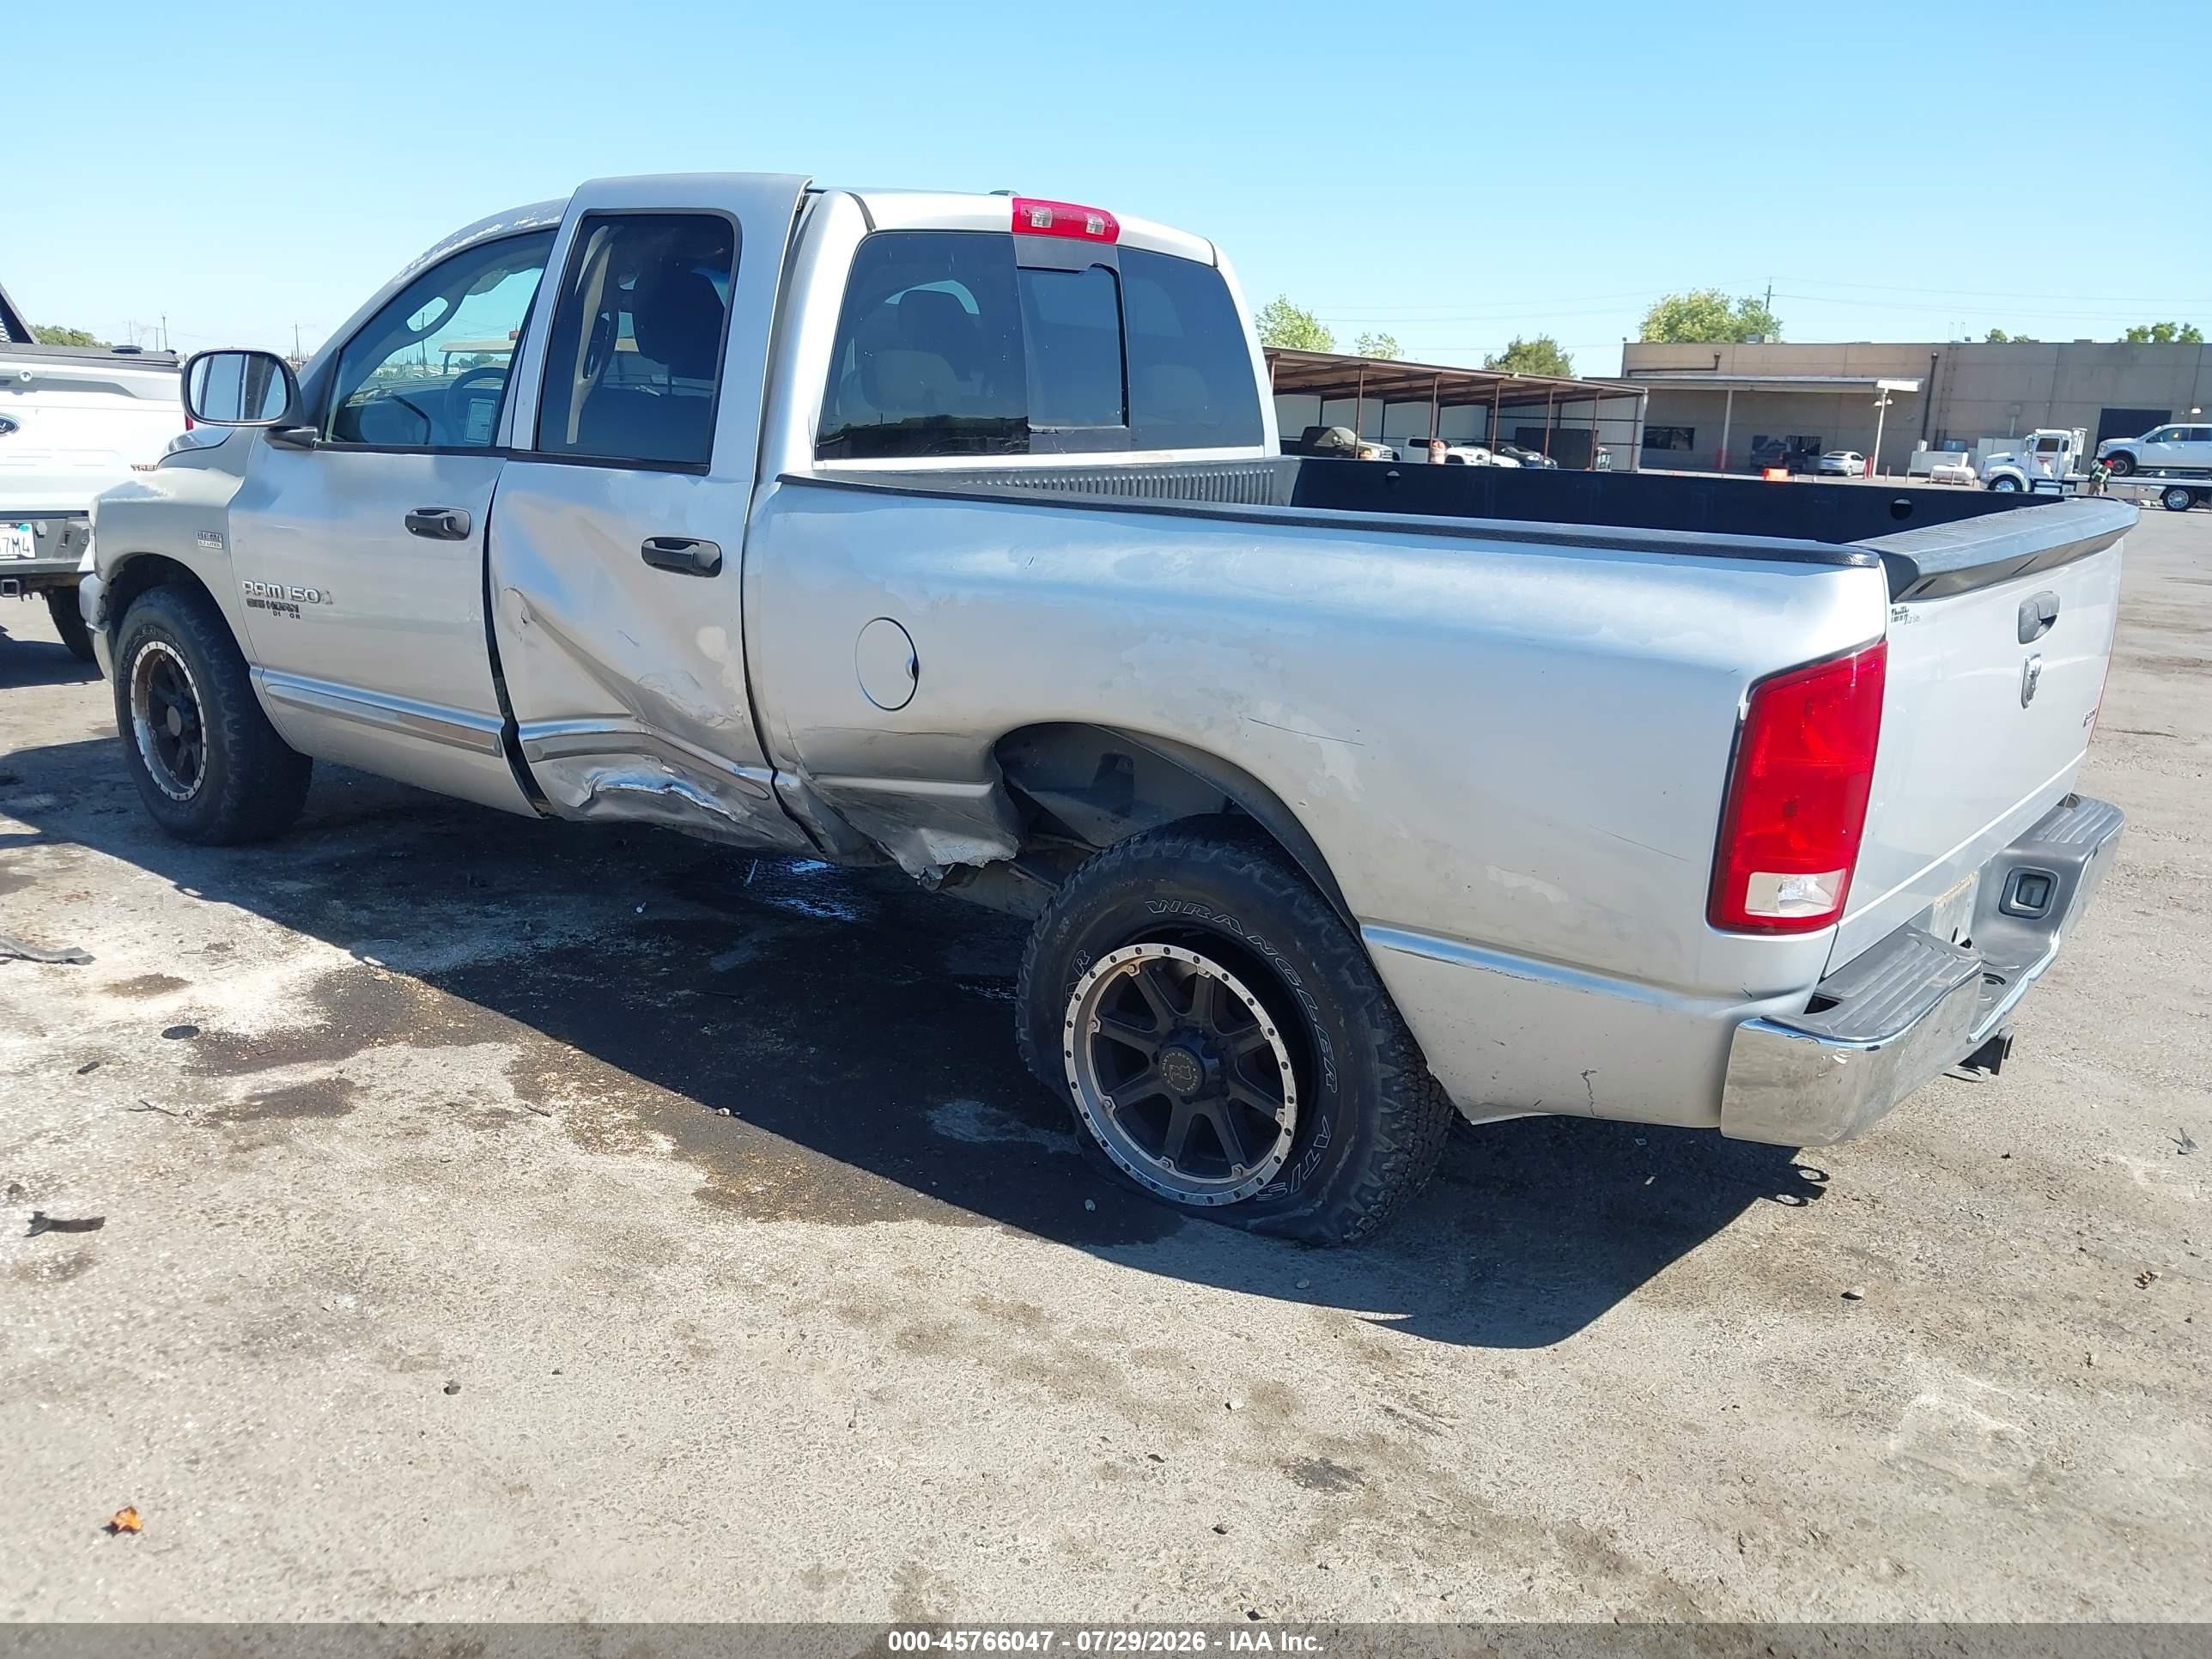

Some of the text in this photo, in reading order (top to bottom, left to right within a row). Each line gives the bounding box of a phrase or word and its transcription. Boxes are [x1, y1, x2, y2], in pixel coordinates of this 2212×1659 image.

[0, 537, 30, 554] 7M4
[242, 580, 284, 599] RAM
[1145, 899, 1339, 1094] WRANGLER
